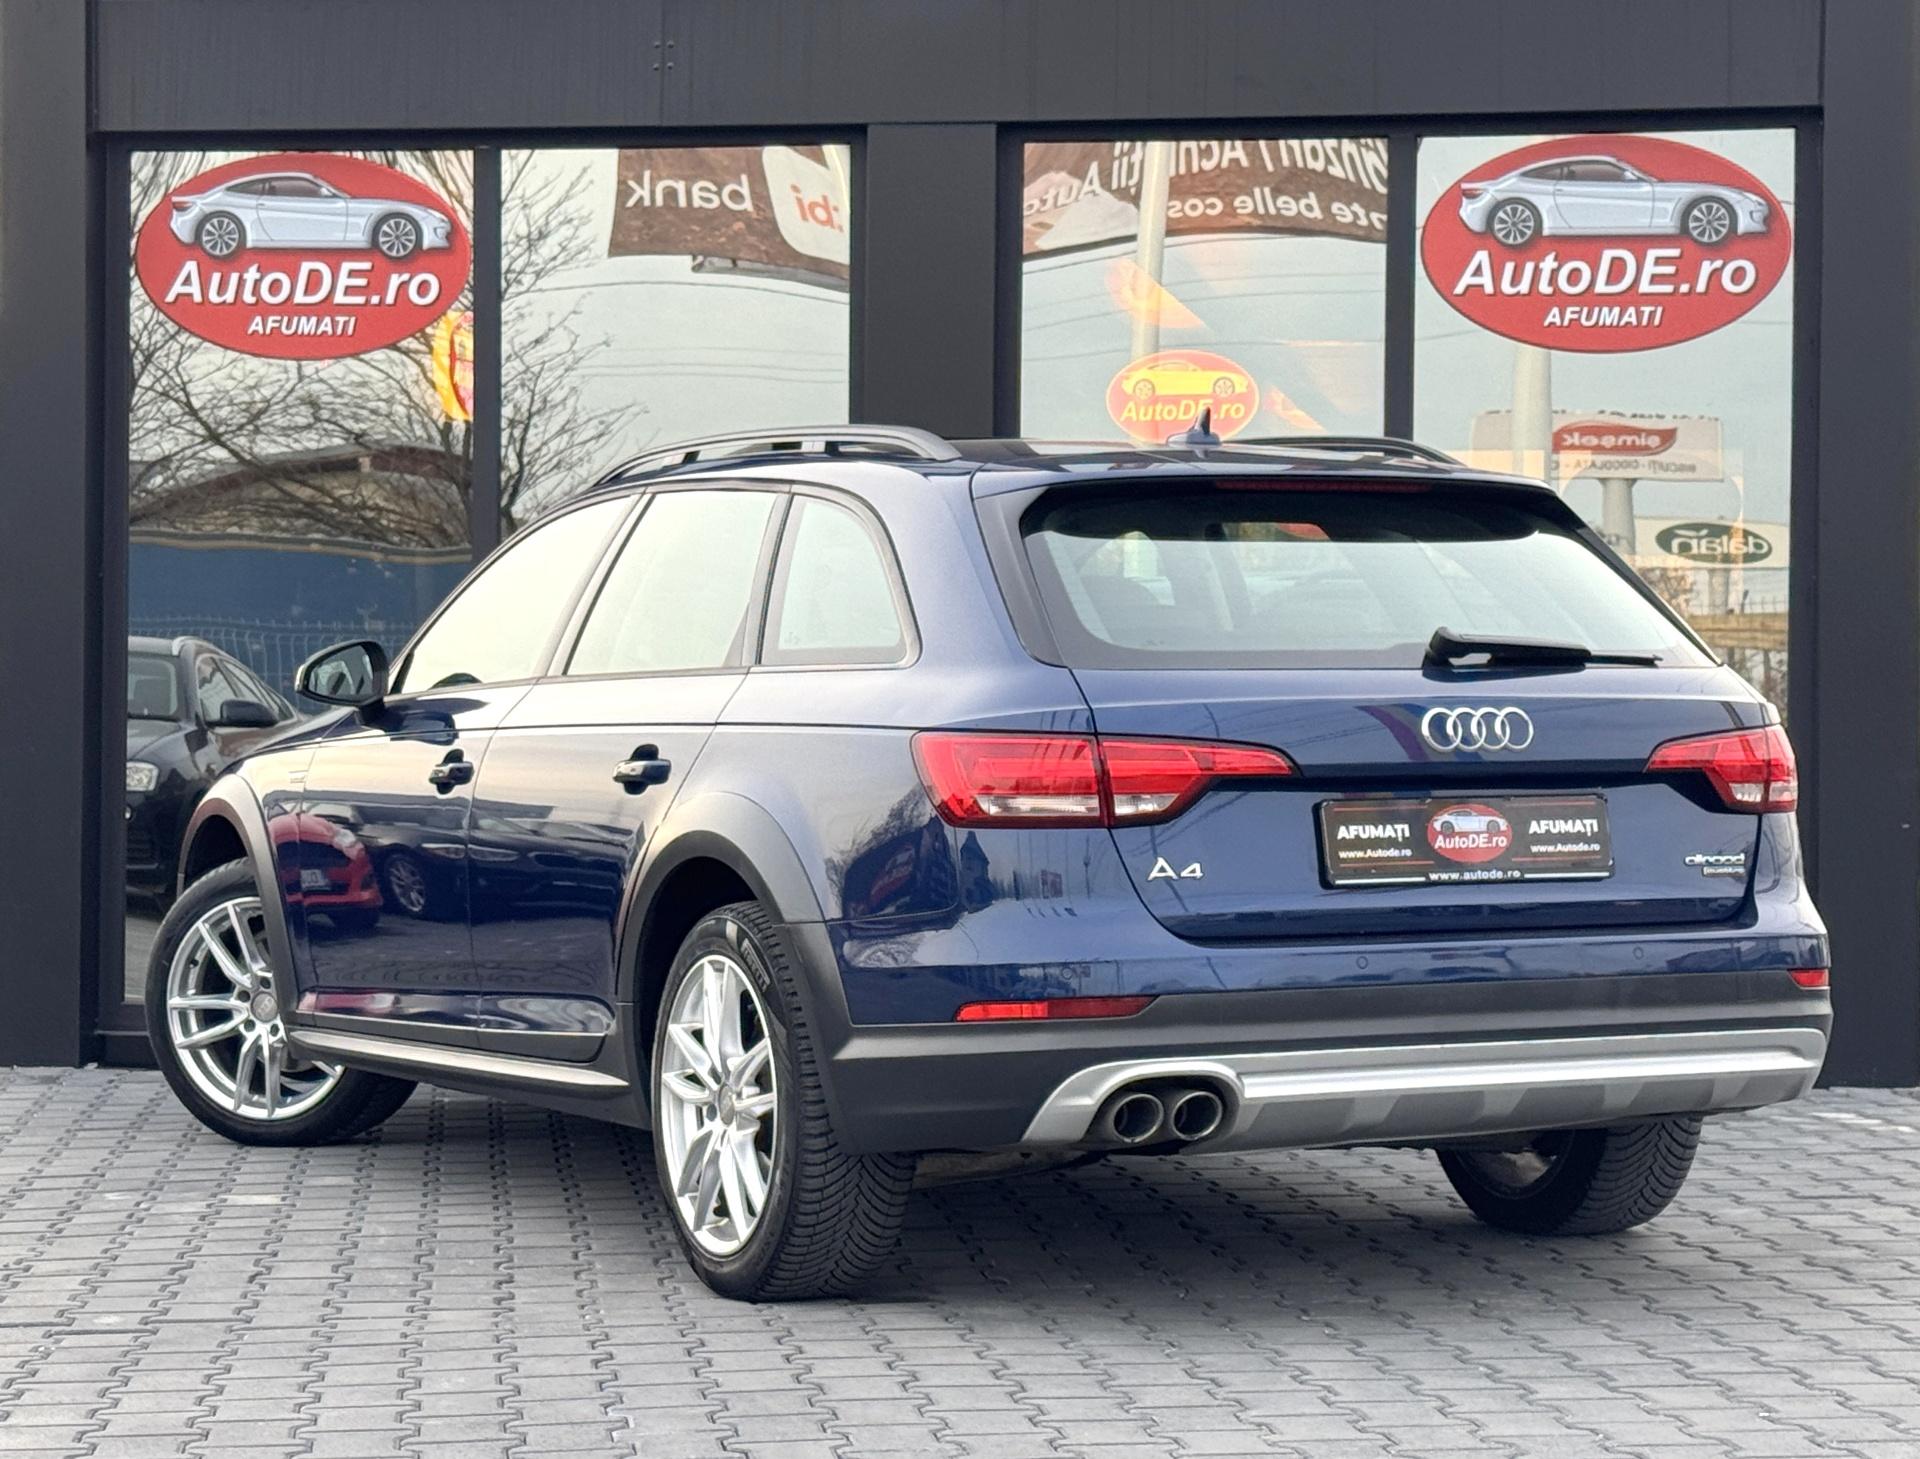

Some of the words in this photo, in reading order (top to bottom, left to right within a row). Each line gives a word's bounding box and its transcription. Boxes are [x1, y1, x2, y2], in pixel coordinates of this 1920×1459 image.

[1452, 247, 1757, 295] AutoDE.ro
[164, 260, 440, 305] AutoDE.ro
[247, 315, 356, 337] AFUMATI
[1544, 306, 1663, 328] AFUMATI
[1434, 833, 1507, 849] AutoDE.ro
[1147, 856, 1204, 881] A4
[1429, 869, 1521, 880] www.autode.ro
